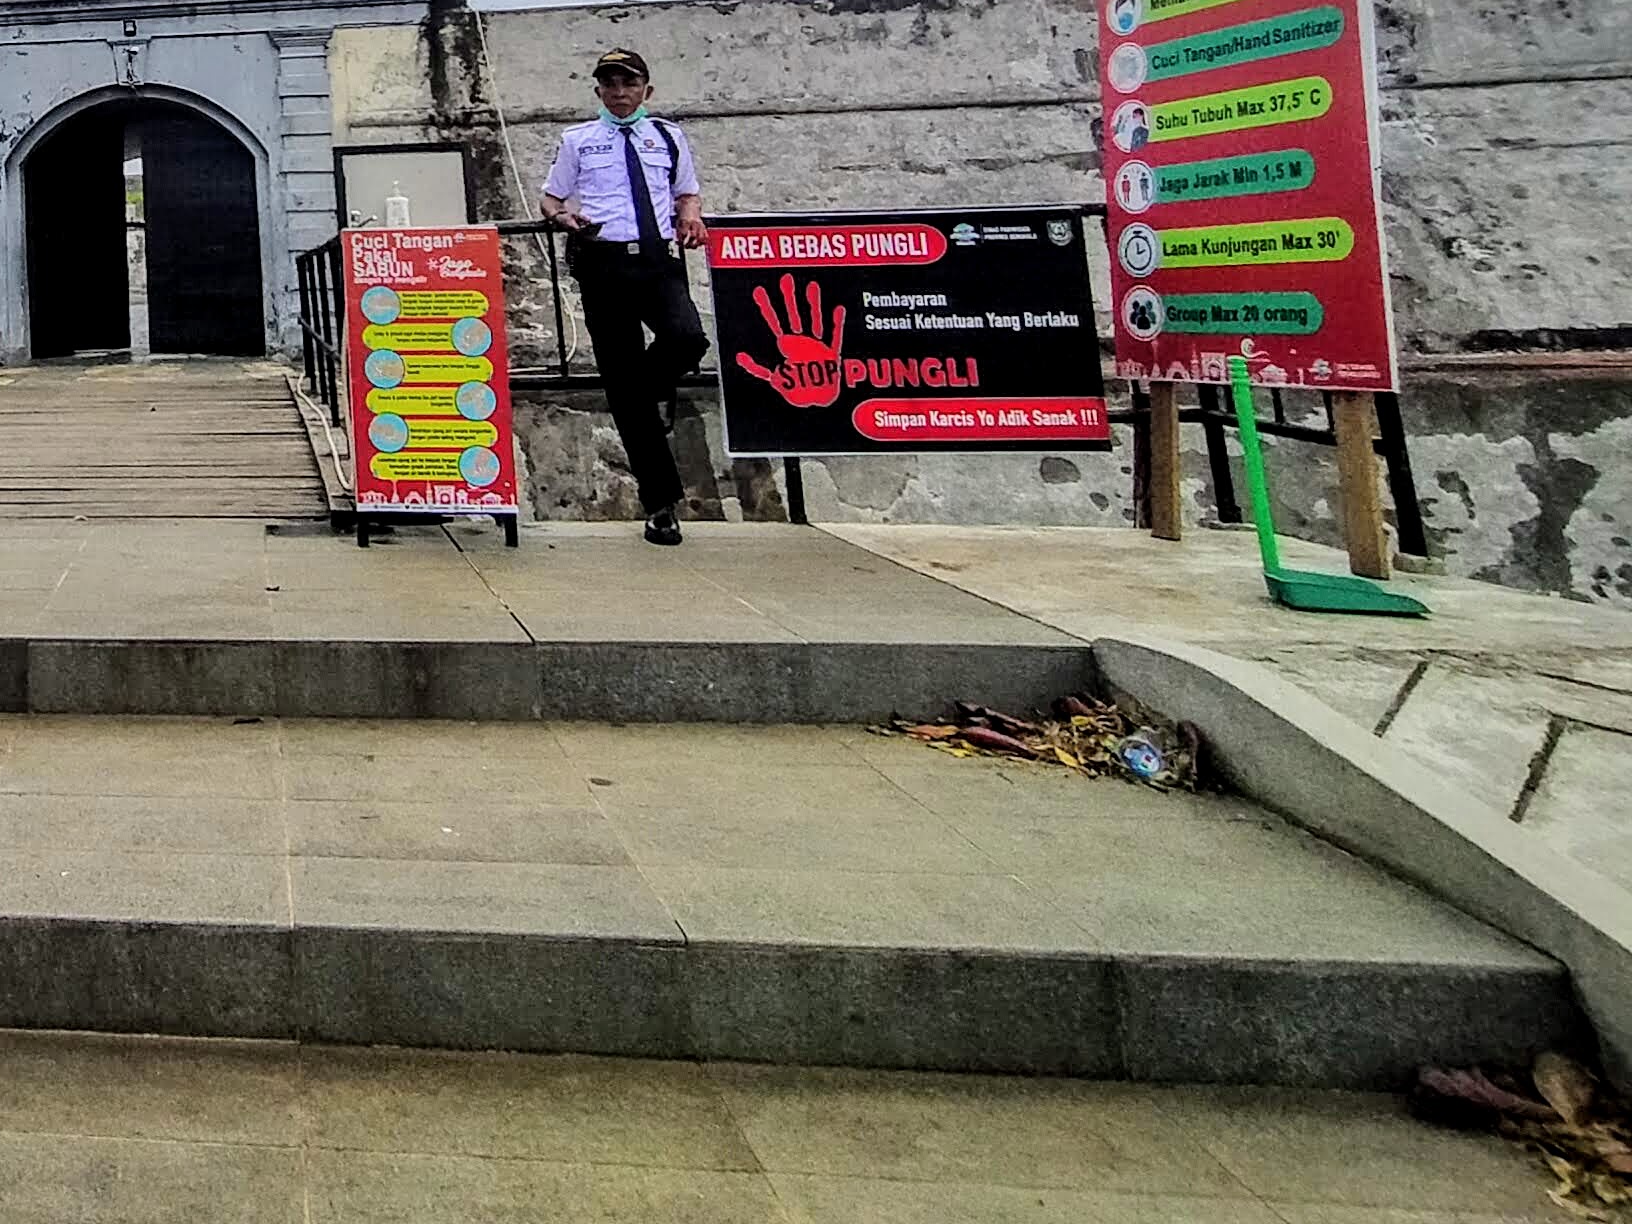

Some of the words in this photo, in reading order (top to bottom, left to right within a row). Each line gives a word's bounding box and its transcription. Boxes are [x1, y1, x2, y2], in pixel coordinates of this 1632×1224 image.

[1151, 52, 1180, 70] Cuci
[1272, 18, 1341, 45] Sanitizer
[1156, 113, 1188, 130] Suhu
[1191, 104, 1233, 125] Tubuh
[1237, 101, 1265, 118] Max
[1263, 162, 1284, 183] 1,5
[1289, 160, 1303, 177] M
[392, 232, 454, 252] Tangan
[721, 235, 775, 260] AREA
[779, 233, 846, 259] BEBAS
[851, 232, 929, 257] PUNGLI
[1162, 241, 1198, 257] Lama
[1201, 236, 1278, 257] Kunjungan
[1281, 233, 1314, 250] Max
[353, 261, 414, 277] SABUN
[863, 291, 948, 310] Pembayaran
[865, 313, 912, 330] Sesuai
[915, 313, 984, 329] Ketentuan
[985, 312, 1021, 331] Yang
[1023, 310, 1080, 327] Berlaku
[1210, 305, 1238, 322] Max
[1241, 305, 1260, 322] 20
[1263, 307, 1308, 327] orang
[778, 359, 838, 391] STOP
[843, 357, 980, 389] PUNGLI
[873, 410, 926, 431] Simpan
[928, 409, 975, 427] Karcis
[976, 410, 995, 427] Yo
[998, 409, 1031, 426] Adik
[1032, 409, 1078, 426] Sanak
[1080, 408, 1099, 426] !!!
